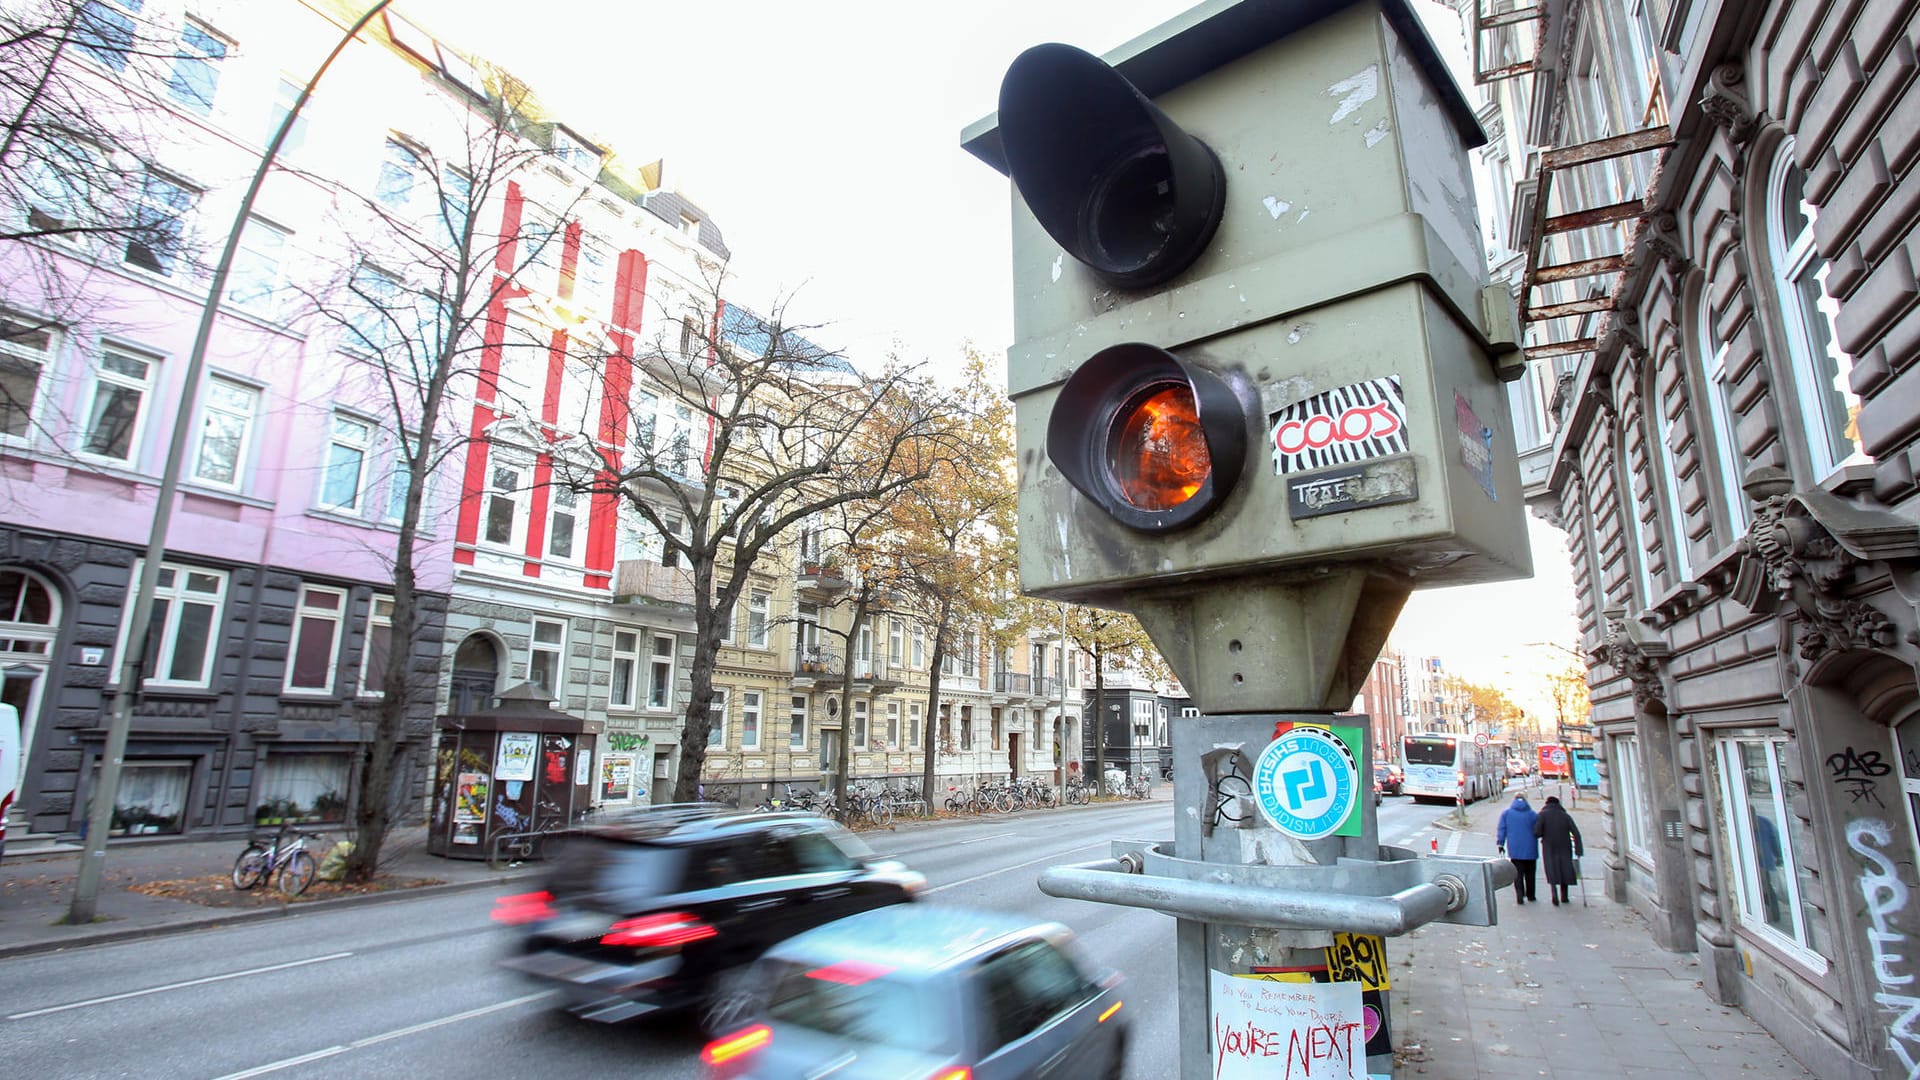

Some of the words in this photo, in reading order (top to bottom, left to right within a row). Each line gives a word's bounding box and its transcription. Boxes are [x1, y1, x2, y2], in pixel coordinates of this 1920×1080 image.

[1301, 739, 1346, 770] ABOUT
[1826, 746, 1892, 777] DAB
[1338, 774, 1349, 801] ALL
[1216, 1013, 1280, 1080] YOU'RE
[1285, 1022, 1361, 1080] NEXT
